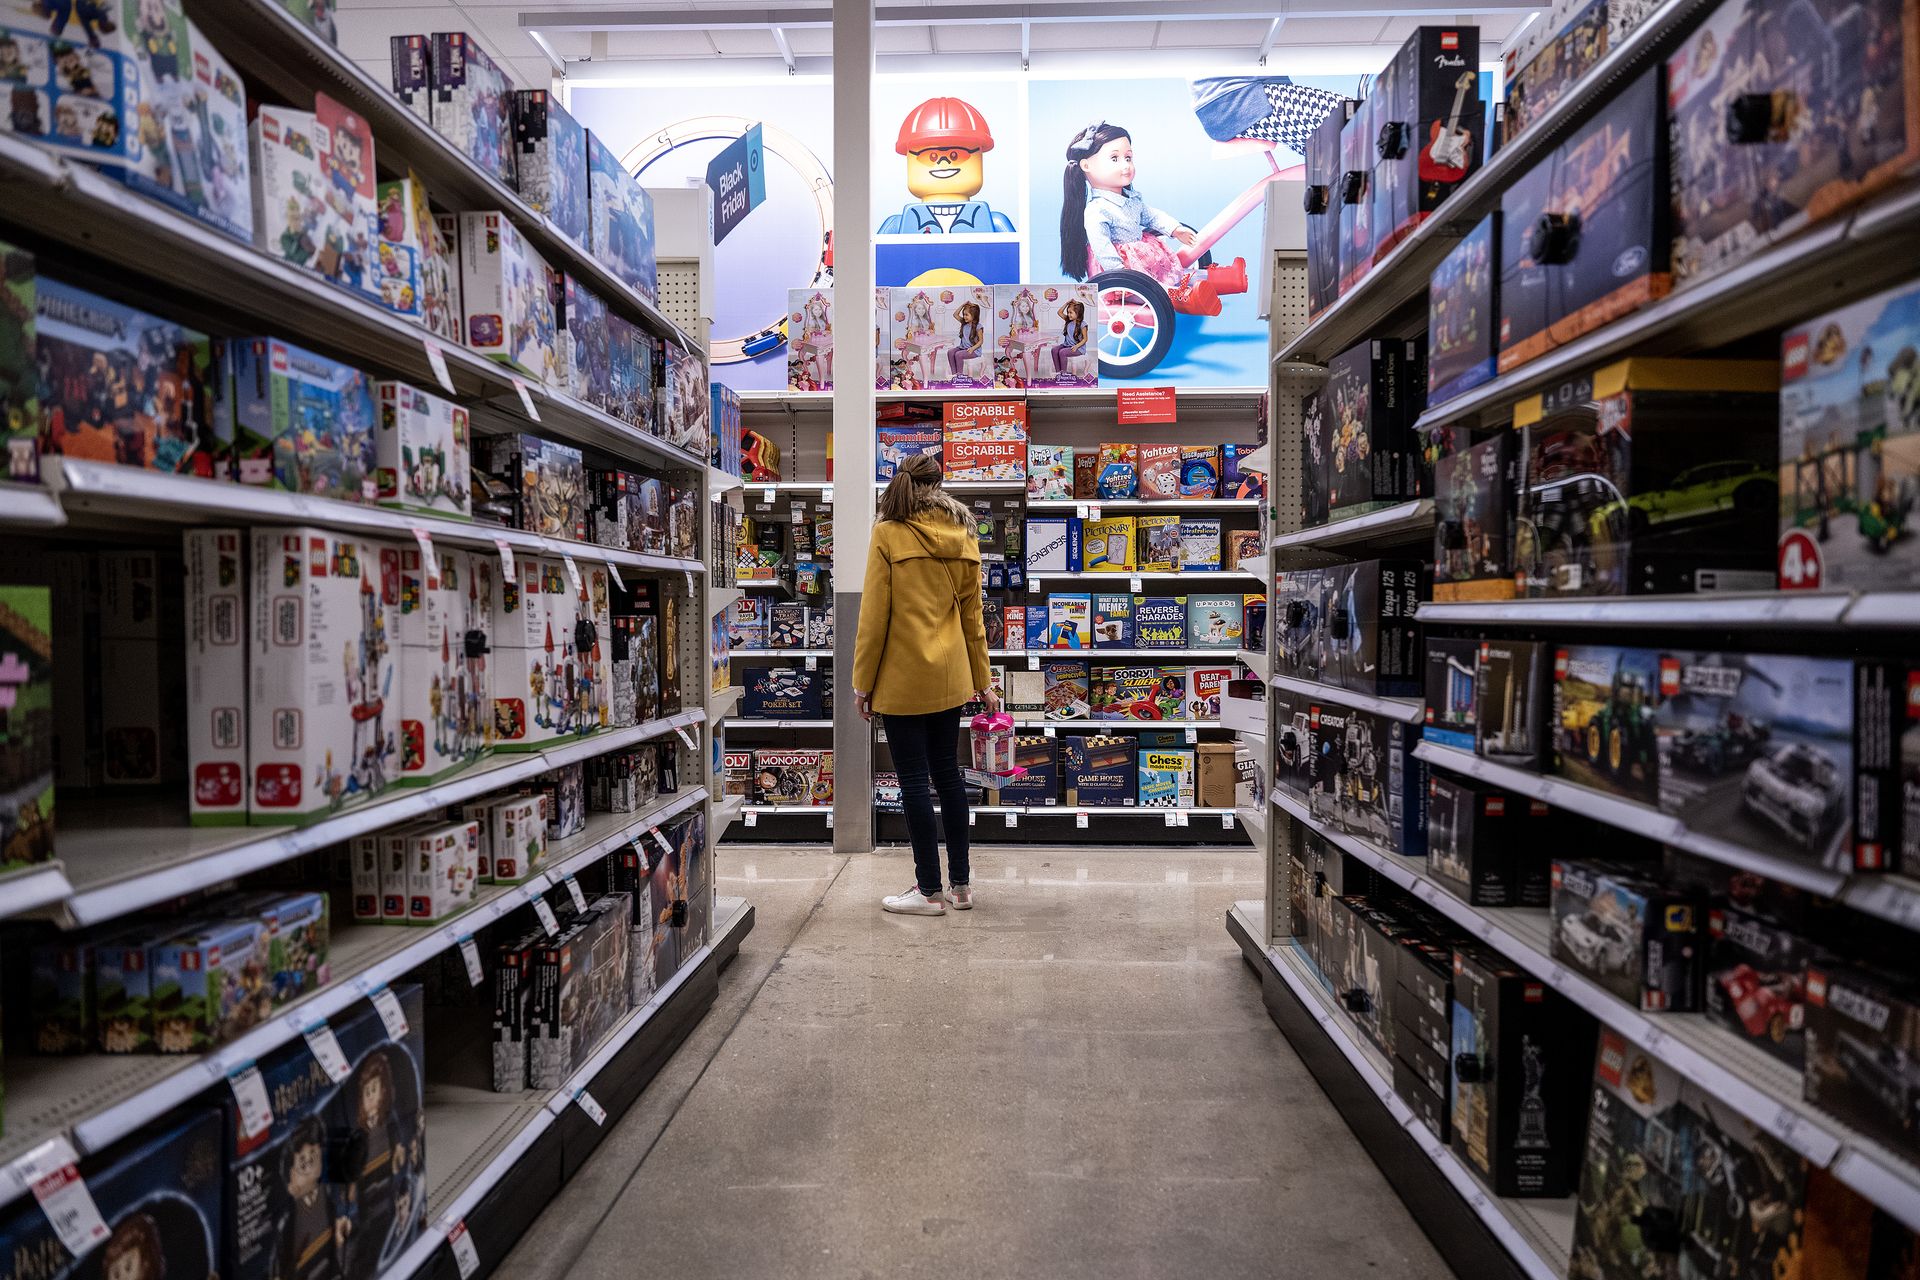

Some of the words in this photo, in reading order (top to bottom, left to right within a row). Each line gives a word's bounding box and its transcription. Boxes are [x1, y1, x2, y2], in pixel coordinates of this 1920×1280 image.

[1434, 55, 1466, 68] Fender
[720, 162, 743, 198] Black
[721, 188, 746, 223] Friday
[1387, 352, 1395, 374] Flores
[1387, 387, 1395, 408] Ramo
[956, 405, 1015, 417] SCRABBLE
[878, 431, 941, 446] Rummikub
[956, 445, 1015, 456] SCRABBLE
[1031, 449, 1051, 461] Jenga
[1141, 445, 1178, 459] Yahtzee
[1236, 447, 1256, 456] Tabo
[1077, 456, 1096, 468] Jenga
[1105, 473, 1132, 483] Yahtzee
[1084, 523, 1130, 537] PICTIONARY
[1027, 534, 1067, 566] SEQUENCE
[1782, 544, 1818, 584] 4+
[1383, 570, 1396, 588] 125
[1404, 570, 1416, 588] 125
[1098, 602, 1128, 612] MEME?
[1382, 591, 1396, 617] Vespa
[1403, 590, 1418, 617] Vespa
[1140, 606, 1179, 614] REVERSE
[1135, 613, 1184, 621] CHARADES
[1115, 668, 1153, 680] SORRY!
[1200, 673, 1219, 681] BEAT
[1123, 678, 1163, 687] SLIDERS
[1200, 681, 1221, 690] PAREN
[762, 700, 788, 708] POKER
[1320, 714, 1344, 728] CREATOR
[760, 756, 818, 765] MONOPOLY
[1149, 755, 1183, 766] Chess
[1022, 775, 1046, 783] HOUSE
[1077, 775, 1099, 783] GAME
[1099, 775, 1124, 783] HOUSE
[238, 1166, 264, 1188] 10+
